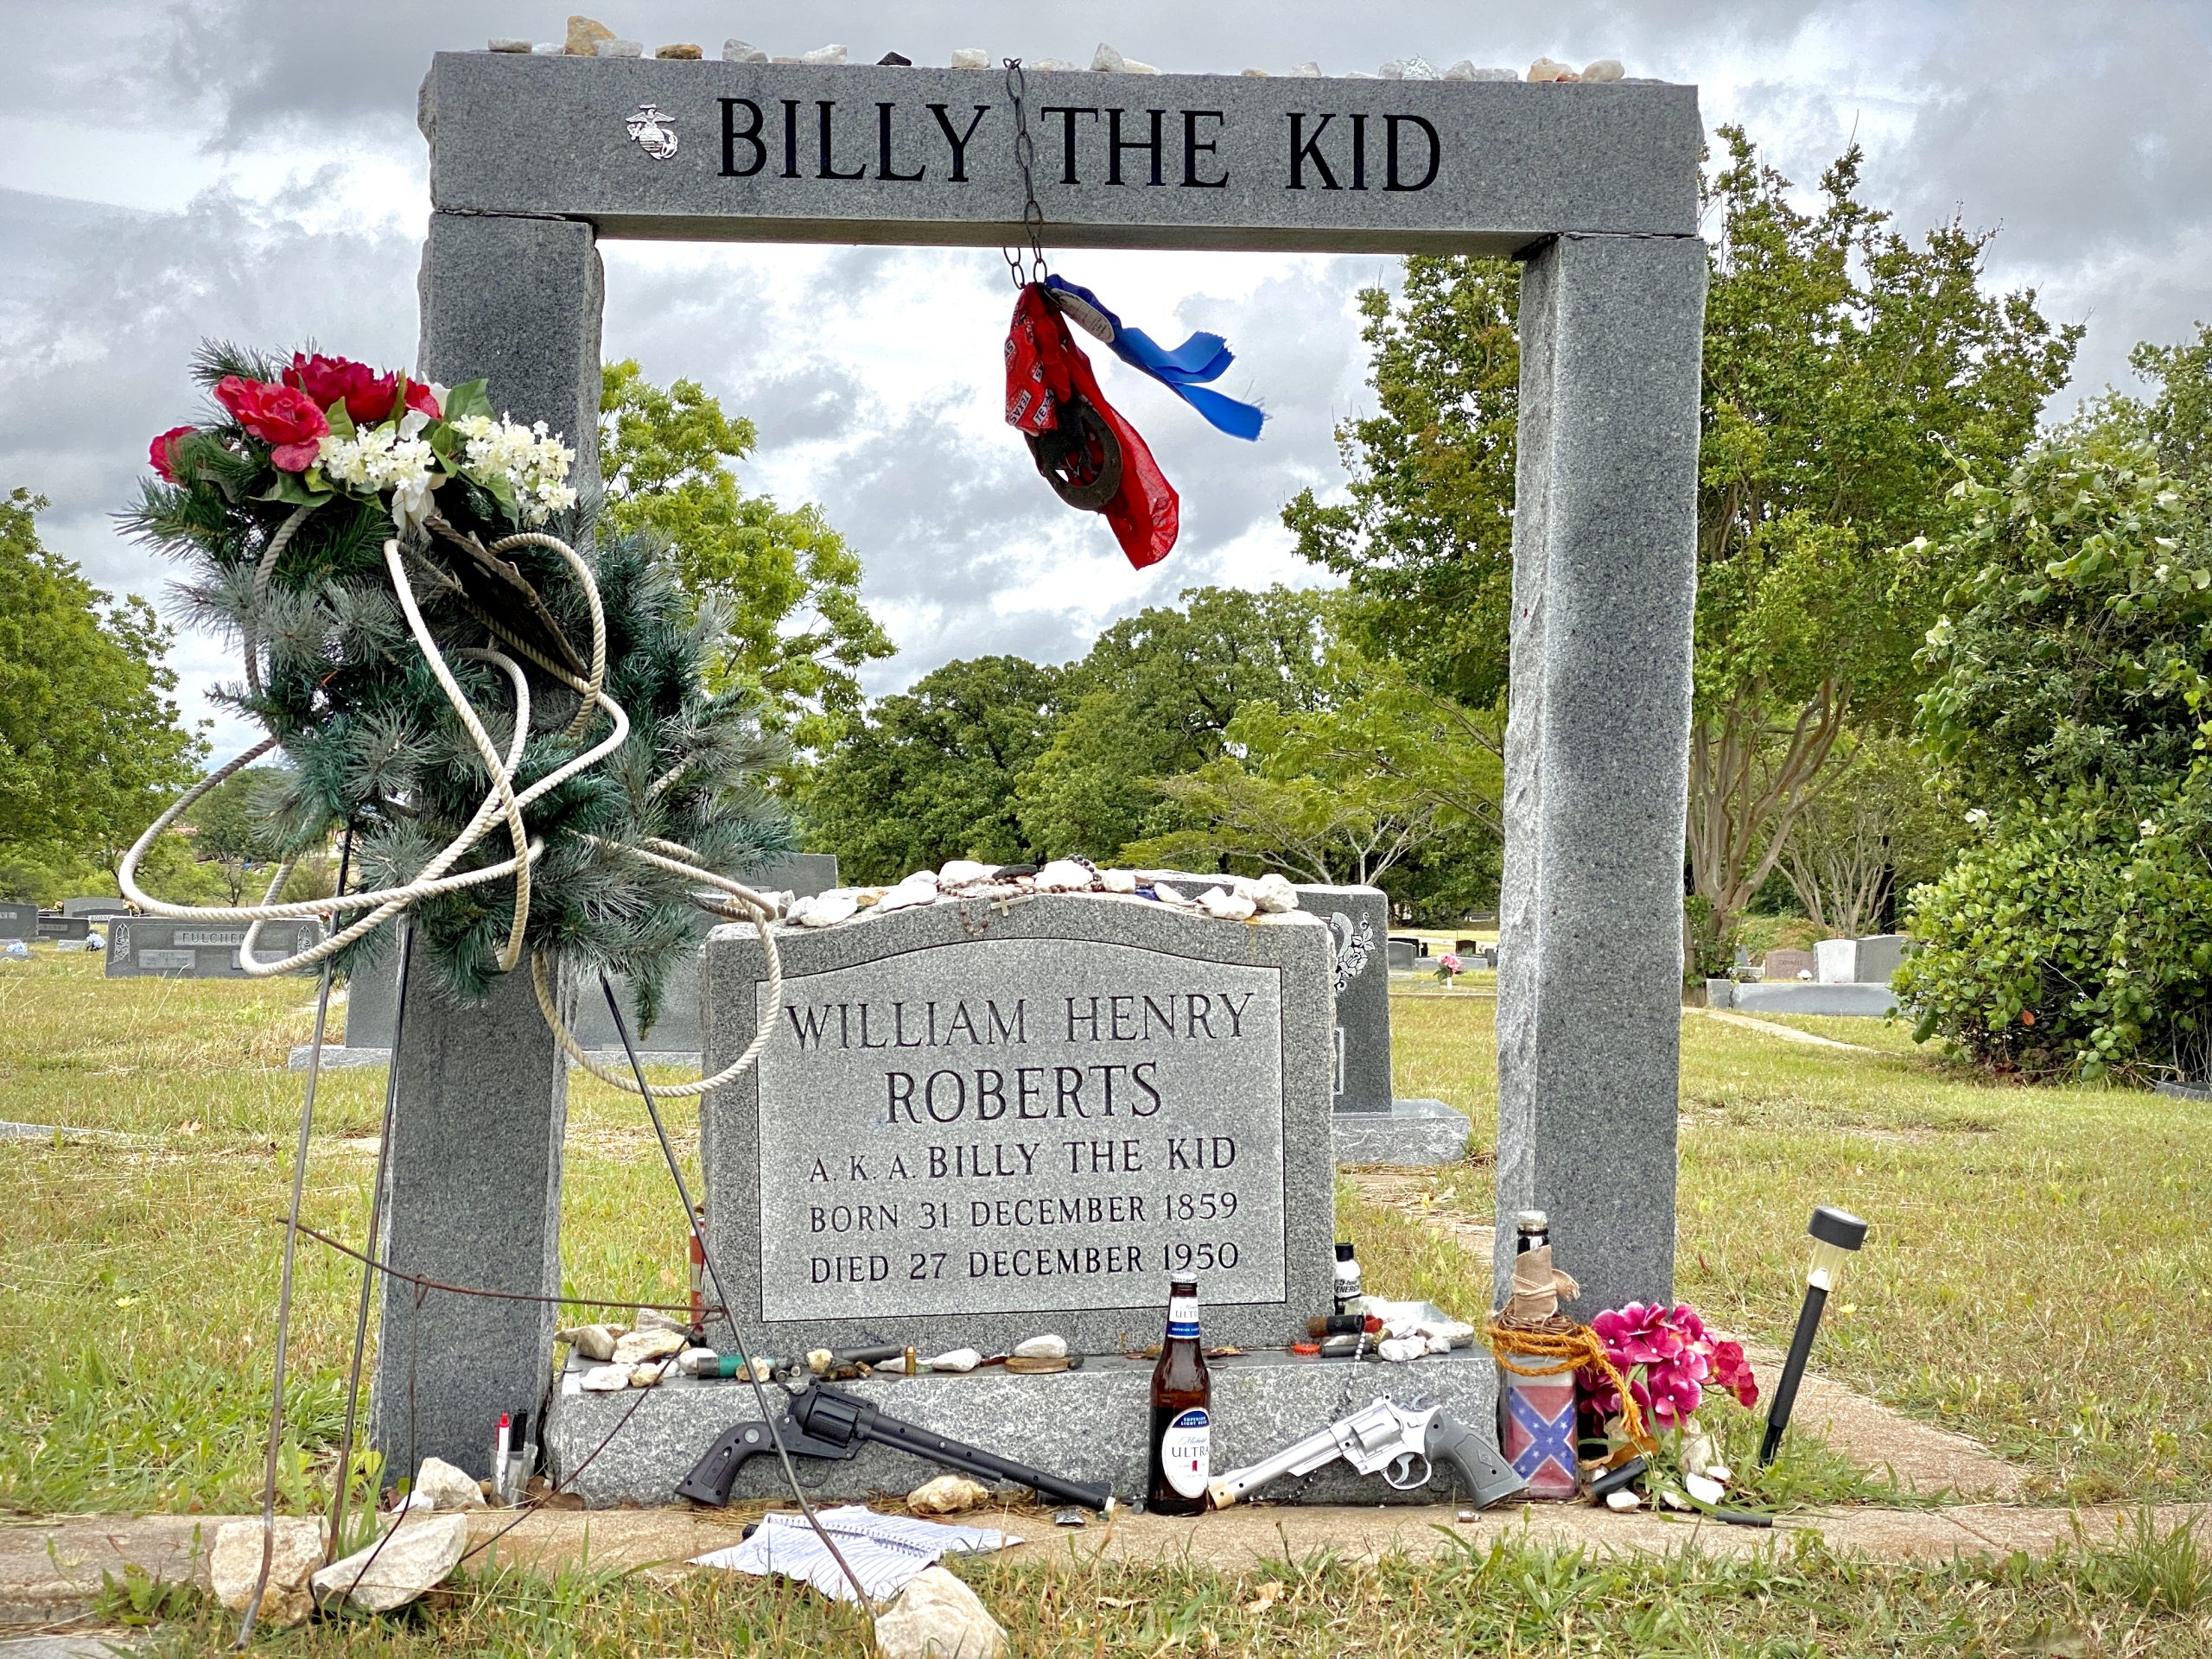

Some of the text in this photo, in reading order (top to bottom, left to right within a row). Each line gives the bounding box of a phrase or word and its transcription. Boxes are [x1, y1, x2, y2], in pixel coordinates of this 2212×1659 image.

[717, 97, 1441, 192] BILLY THE KID
[182, 933, 245, 943] FULCHER
[785, 992, 1255, 1051] WILLIAM HENRY
[885, 1061, 1162, 1123] ROBERTS
[929, 1141, 1040, 1179] BILLY
[1063, 1140, 1143, 1174] THE
[1167, 1136, 1236, 1172] KID
[810, 1192, 1238, 1232] BORN 31 DECEMBER 1859
[811, 1242, 1239, 1283] DIED 27 DECEMBER 1950
